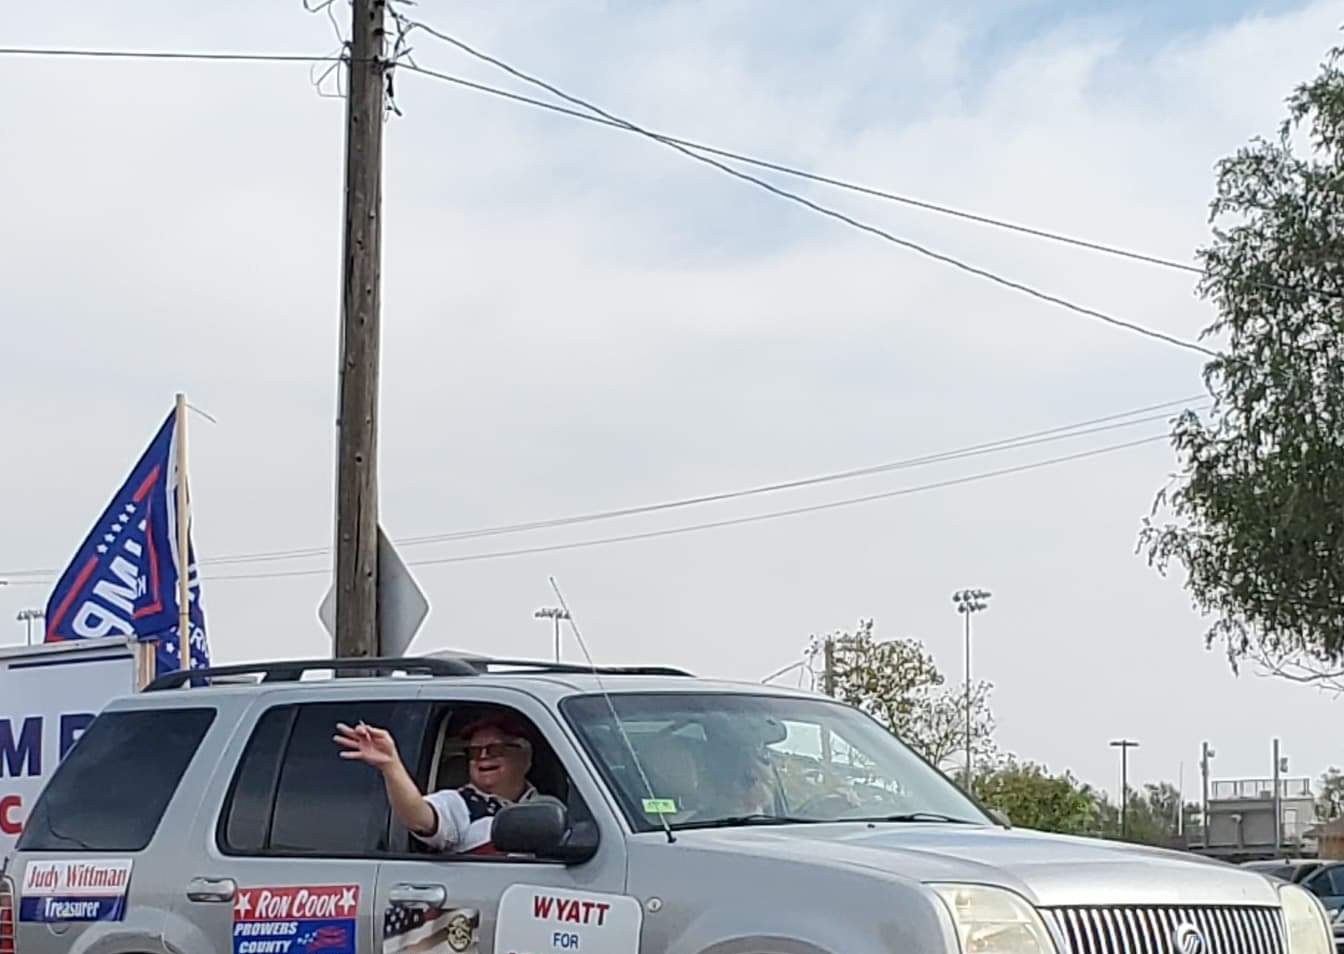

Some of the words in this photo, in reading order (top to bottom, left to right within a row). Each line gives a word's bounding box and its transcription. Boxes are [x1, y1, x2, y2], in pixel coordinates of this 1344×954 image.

[28, 865, 58, 892] Judy
[65, 864, 127, 888] Wittman
[44, 897, 100, 918] Treasurer
[533, 896, 610, 926] WYATT
[234, 922, 298, 936] PROWERS
[239, 940, 292, 954] COUNTY
[553, 932, 579, 949] FOR
